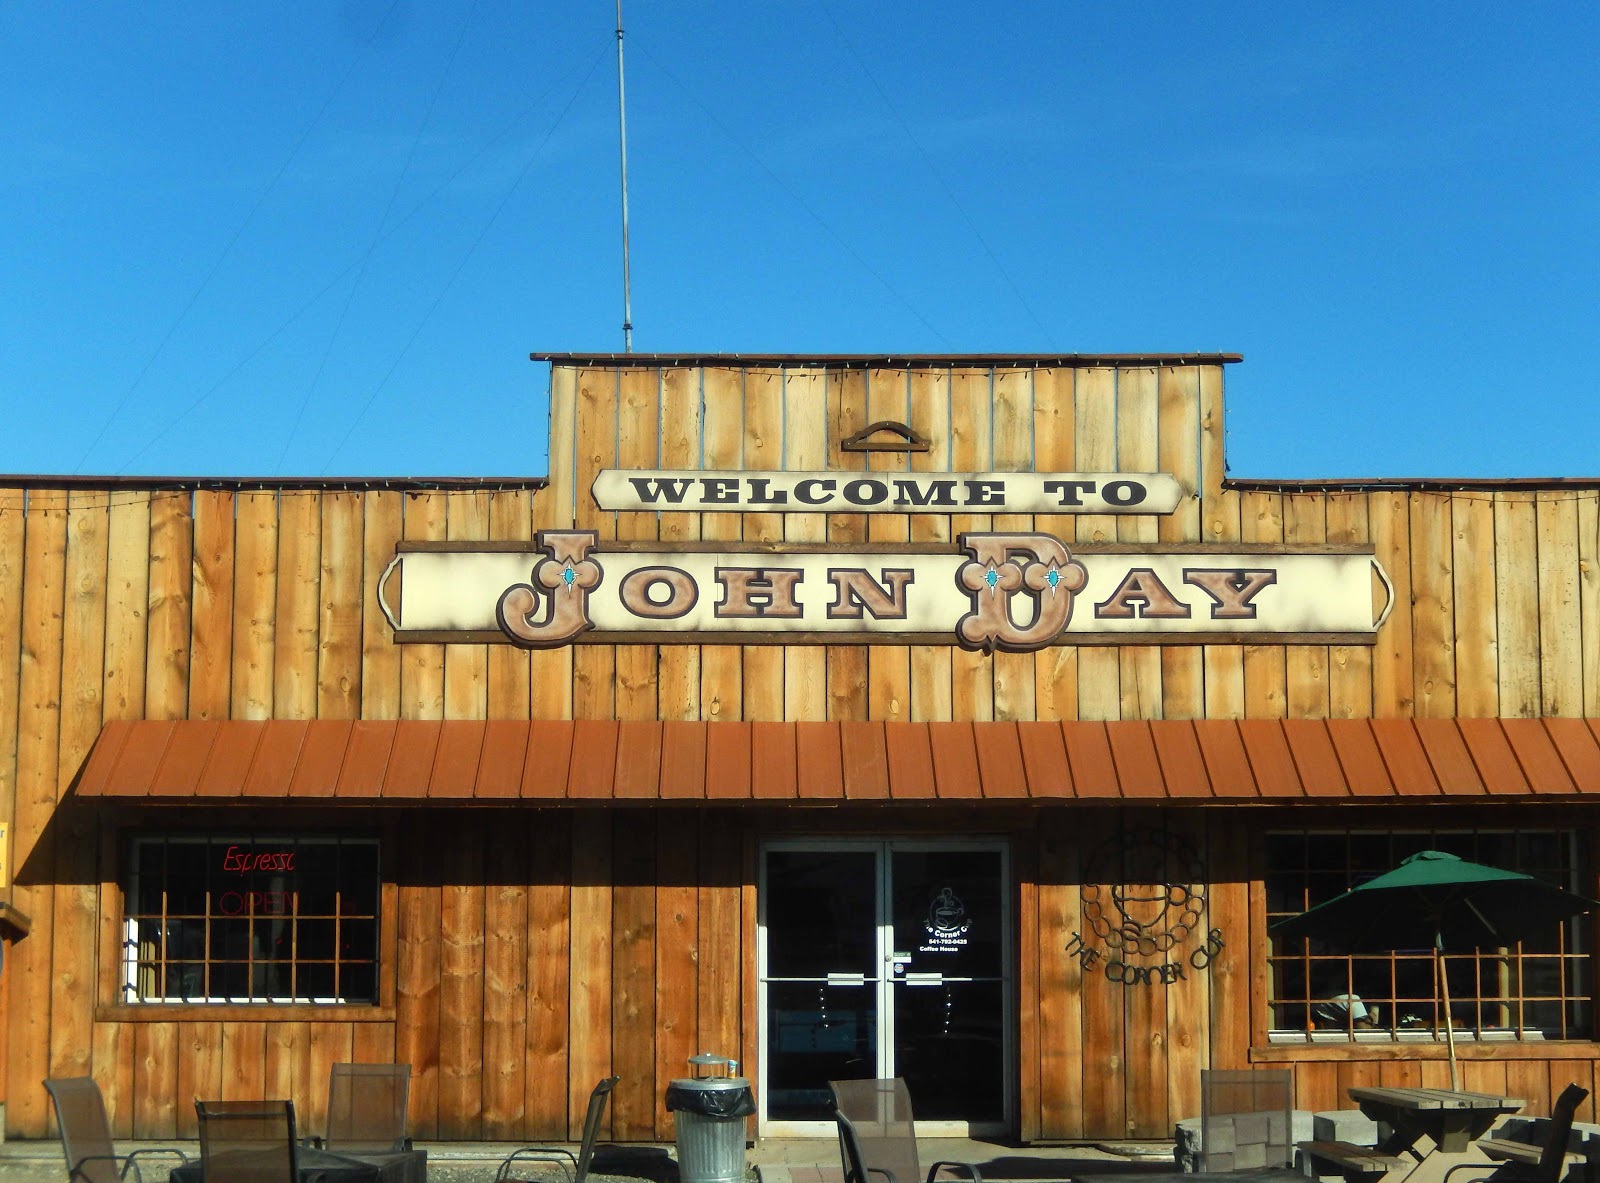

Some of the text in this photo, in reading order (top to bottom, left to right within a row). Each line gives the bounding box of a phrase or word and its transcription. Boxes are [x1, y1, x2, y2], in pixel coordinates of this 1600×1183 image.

[629, 478, 1147, 506] WELCOME TO
[496, 529, 1277, 655] JOHN DAY
[219, 891, 298, 916] OPEN
[934, 930, 961, 938] Corner
[1065, 931, 1101, 972] THE
[1105, 960, 1187, 986] CORNER
